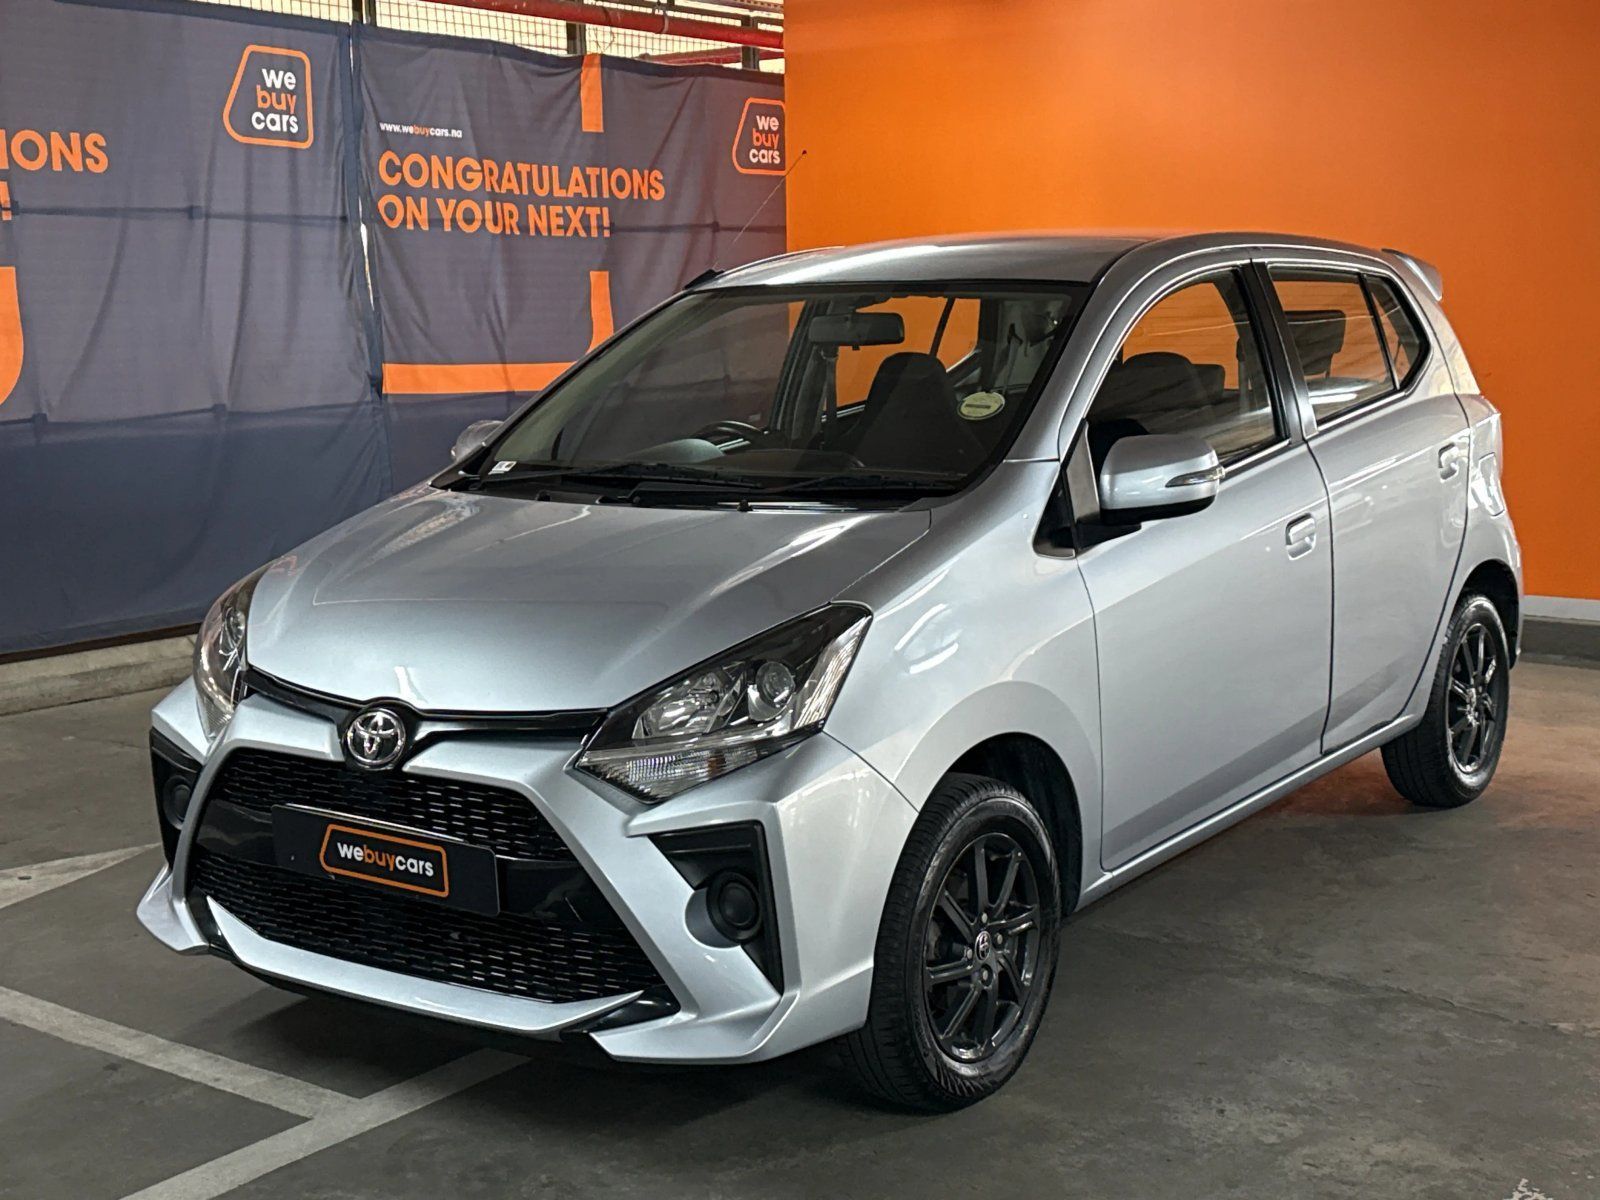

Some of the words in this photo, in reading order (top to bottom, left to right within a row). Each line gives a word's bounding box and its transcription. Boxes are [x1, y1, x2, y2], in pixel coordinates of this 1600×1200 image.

[262, 68, 296, 89] we
[256, 85, 296, 114] buy
[251, 111, 299, 133] cars
[379, 122, 462, 138] www.webuycars.na
[756, 115, 780, 131] we
[752, 129, 780, 149] buy
[749, 149, 781, 164] cars
[378, 151, 665, 199] CONGRATULATIONS
[378, 194, 429, 231] ON
[435, 198, 520, 235] YOUR
[527, 204, 611, 238] NEXT!
[337, 842, 434, 877] webuycars
